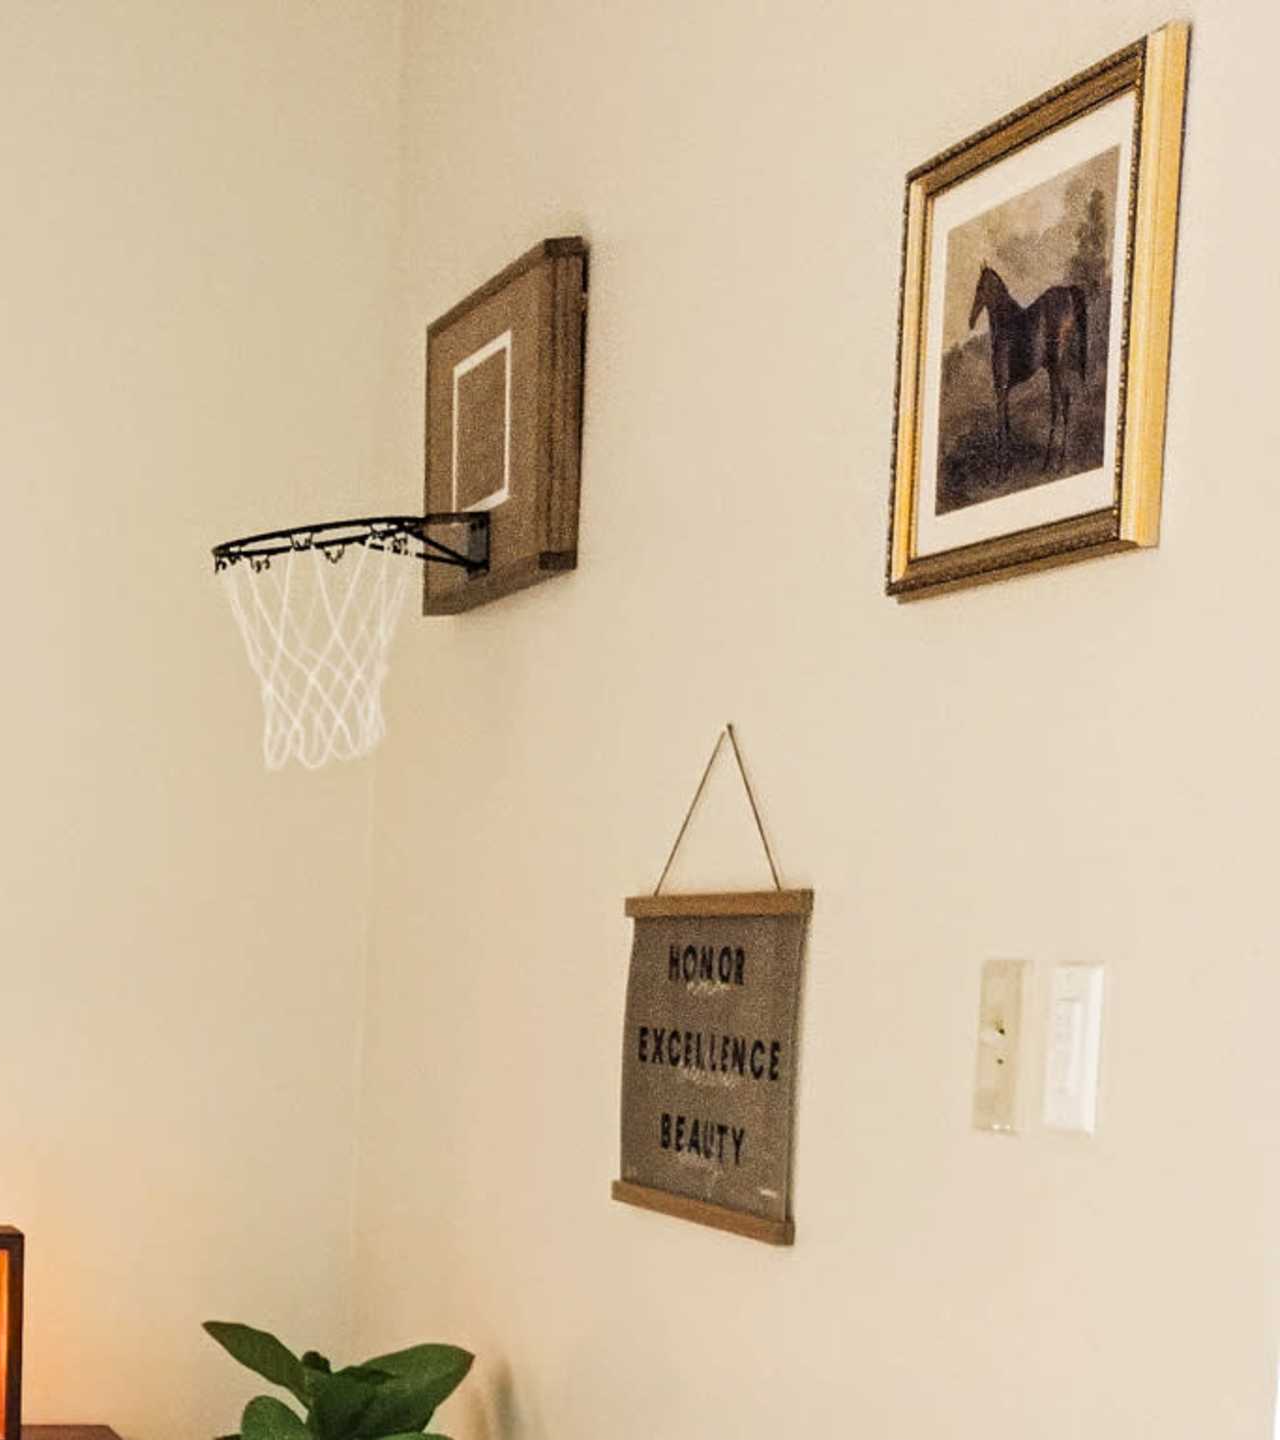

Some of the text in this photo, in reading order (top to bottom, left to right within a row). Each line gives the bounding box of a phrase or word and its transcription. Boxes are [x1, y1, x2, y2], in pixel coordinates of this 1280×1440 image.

[668, 945, 745, 986] HONOR
[639, 1026, 781, 1081] EXCELLENCE
[660, 1113, 745, 1166] BEAUTY
